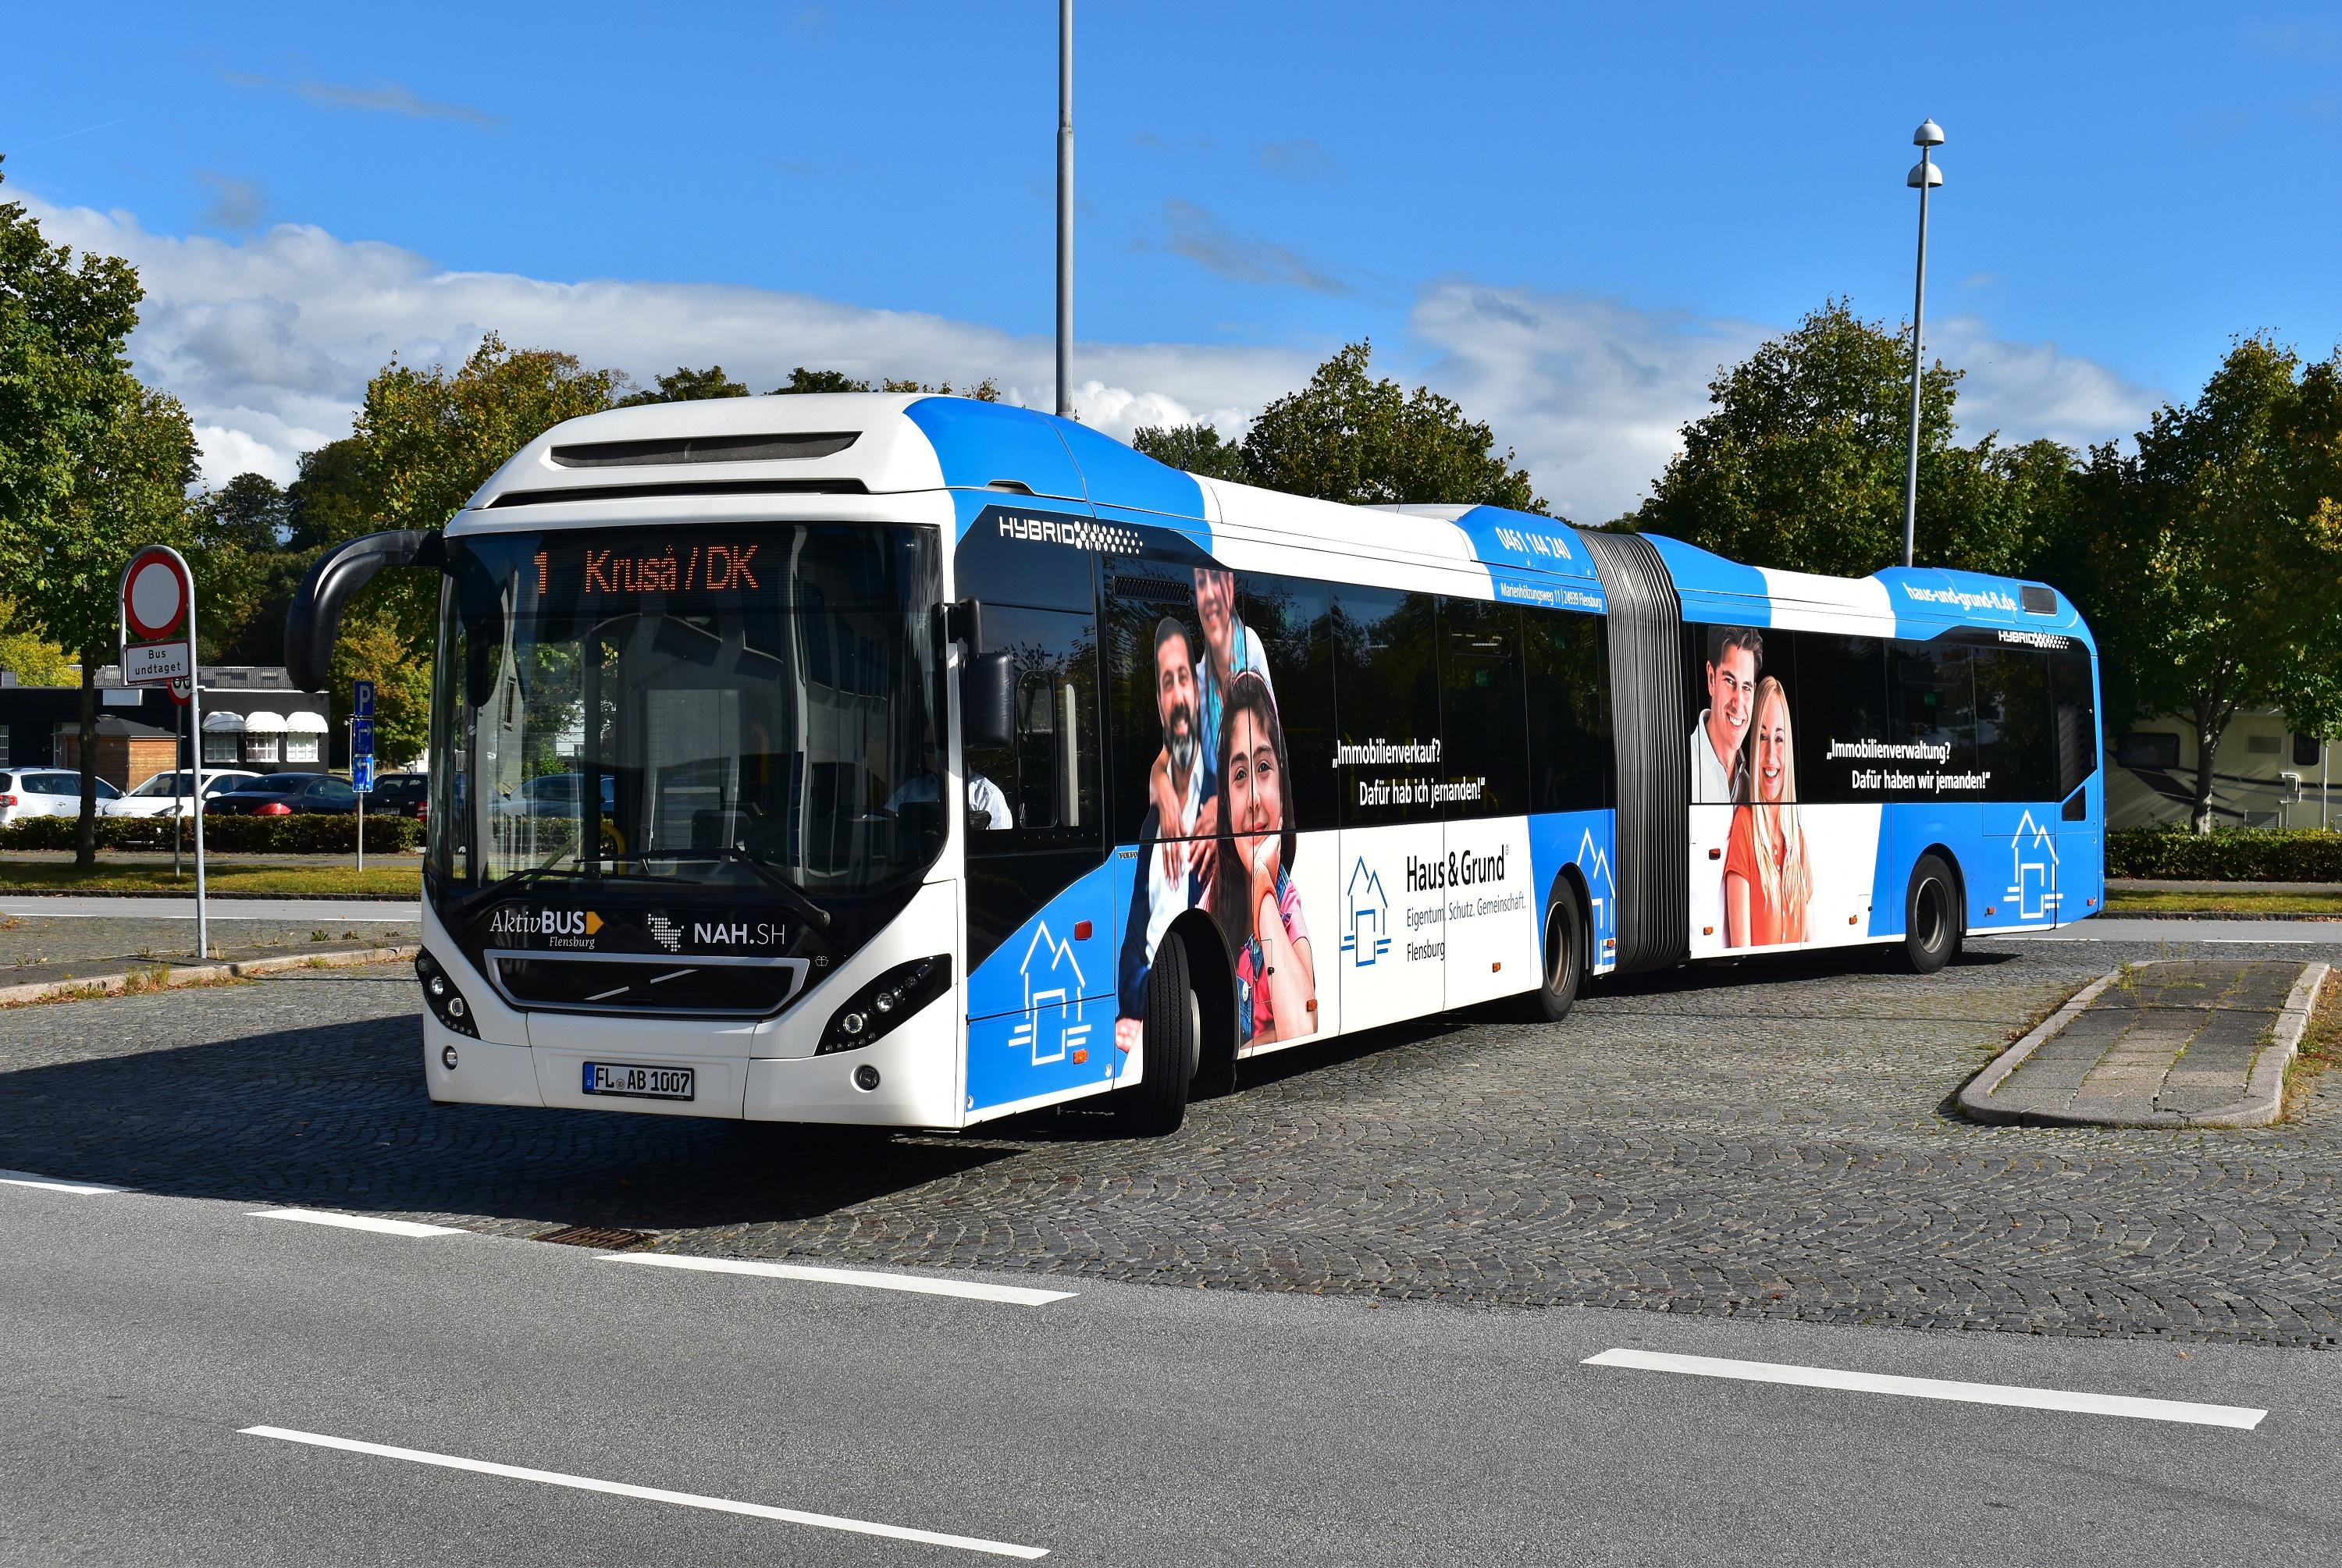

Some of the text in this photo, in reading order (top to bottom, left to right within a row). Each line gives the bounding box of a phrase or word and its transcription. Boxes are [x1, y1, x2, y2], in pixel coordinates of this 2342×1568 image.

[998, 516, 1074, 544] HYBRID
[1495, 526, 1572, 560] 0461 144 240
[534, 552, 547, 593] 1
[1500, 581, 1554, 606] Marienhölzungsweg
[1579, 592, 1603, 611] Flensburg
[1902, 582, 2017, 611] haus-und-grund-fl.de
[1999, 630, 2034, 644] HYBRID
[135, 661, 181, 675] undtaget
[148, 649, 166, 660] Bus
[359, 685, 371, 713] P
[1359, 779, 1390, 806] Dafür
[1392, 778, 1412, 805] hab
[1415, 777, 1429, 803] ich
[1852, 769, 1882, 789] Dafür
[1884, 769, 1915, 789] haben
[1917, 770, 1934, 789] wir
[1407, 855, 1444, 893] Haus
[1448, 851, 1459, 887] &
[489, 911, 585, 934] AktivBUS
[1407, 891, 1526, 931] Eigentum. Schutz. Gemeinschaft.
[549, 936, 596, 950] Flensburg
[694, 923, 785, 944] NAH.SH
[1407, 939, 1445, 962] Flensburg
[595, 1067, 614, 1088] FL
[627, 1070, 646, 1090] AB
[650, 1071, 690, 1093] 1007
